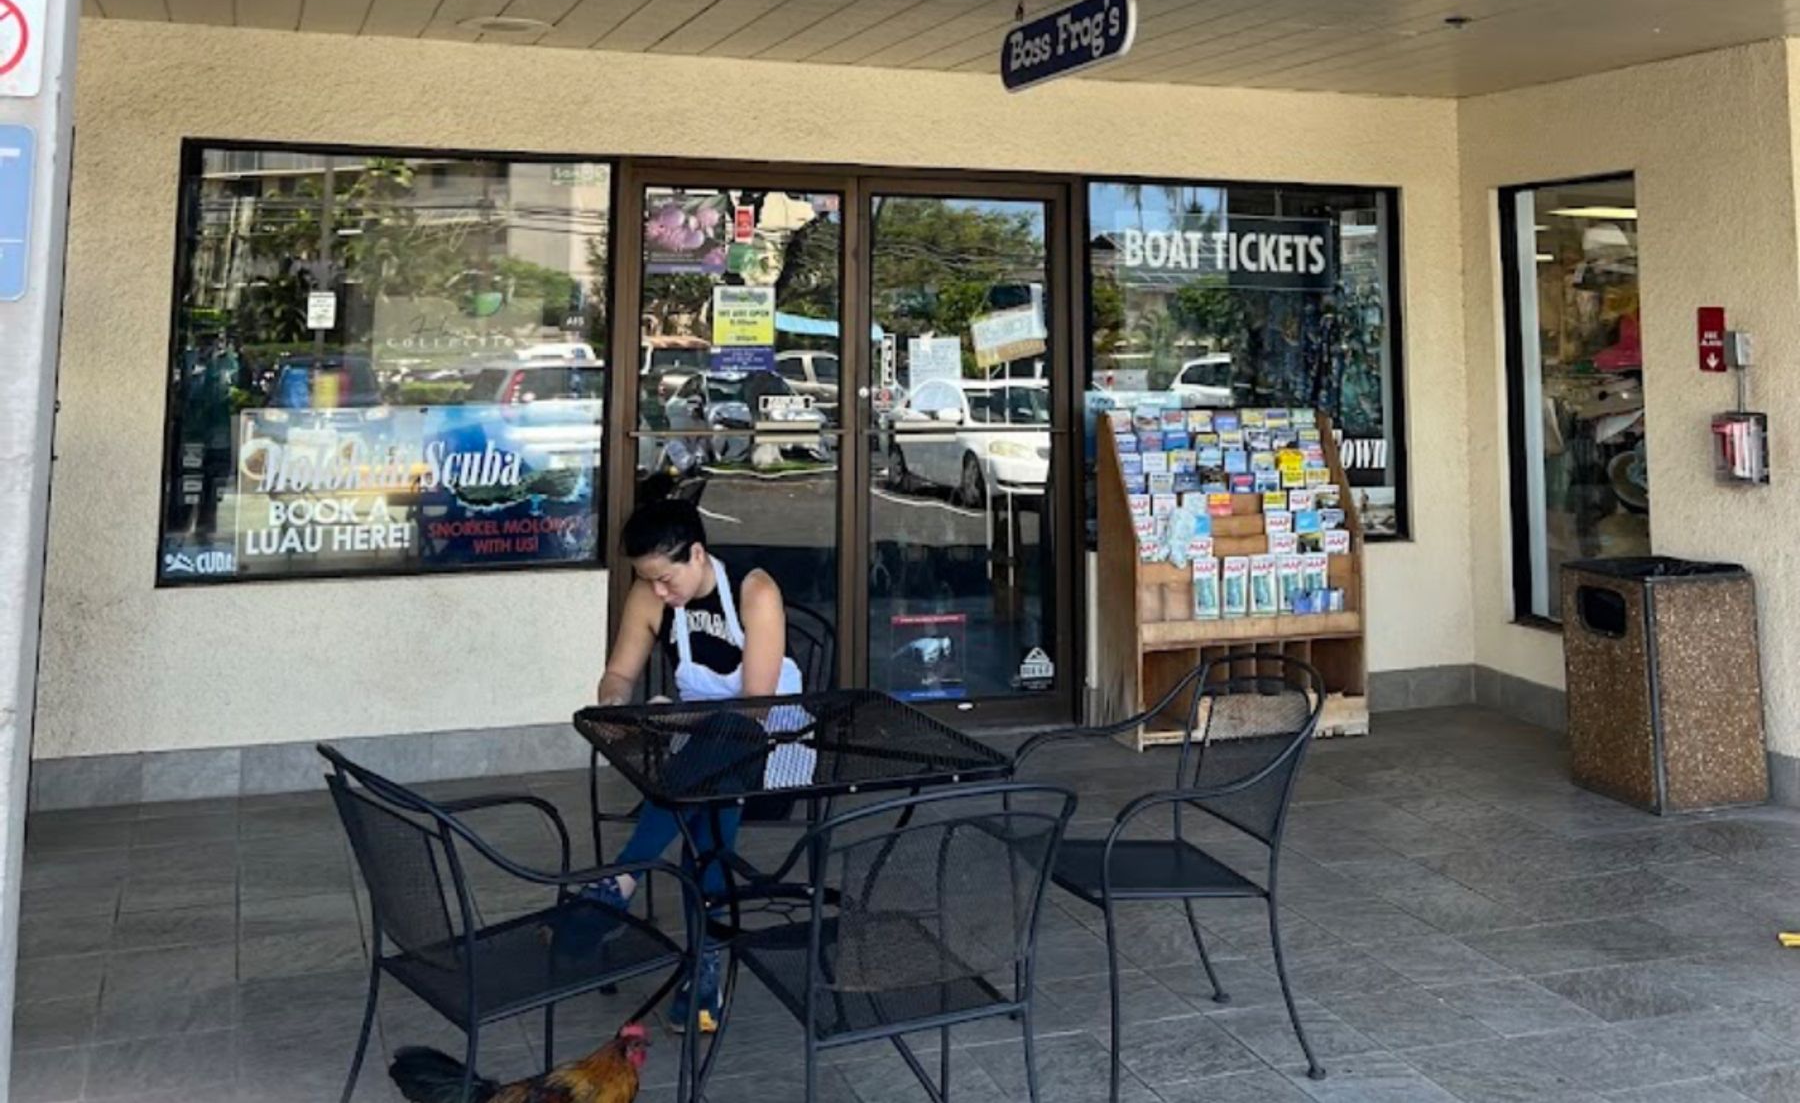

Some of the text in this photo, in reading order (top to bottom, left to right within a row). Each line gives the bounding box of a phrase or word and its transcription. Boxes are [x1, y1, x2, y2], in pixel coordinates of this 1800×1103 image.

[1010, 31, 1051, 72] Boss
[1125, 228, 1326, 274] BOAT TICKETS
[420, 439, 521, 492] Scuba
[269, 496, 391, 526] BOOK A
[245, 523, 411, 555] LUAU HERE!
[473, 538, 512, 554] WITH
